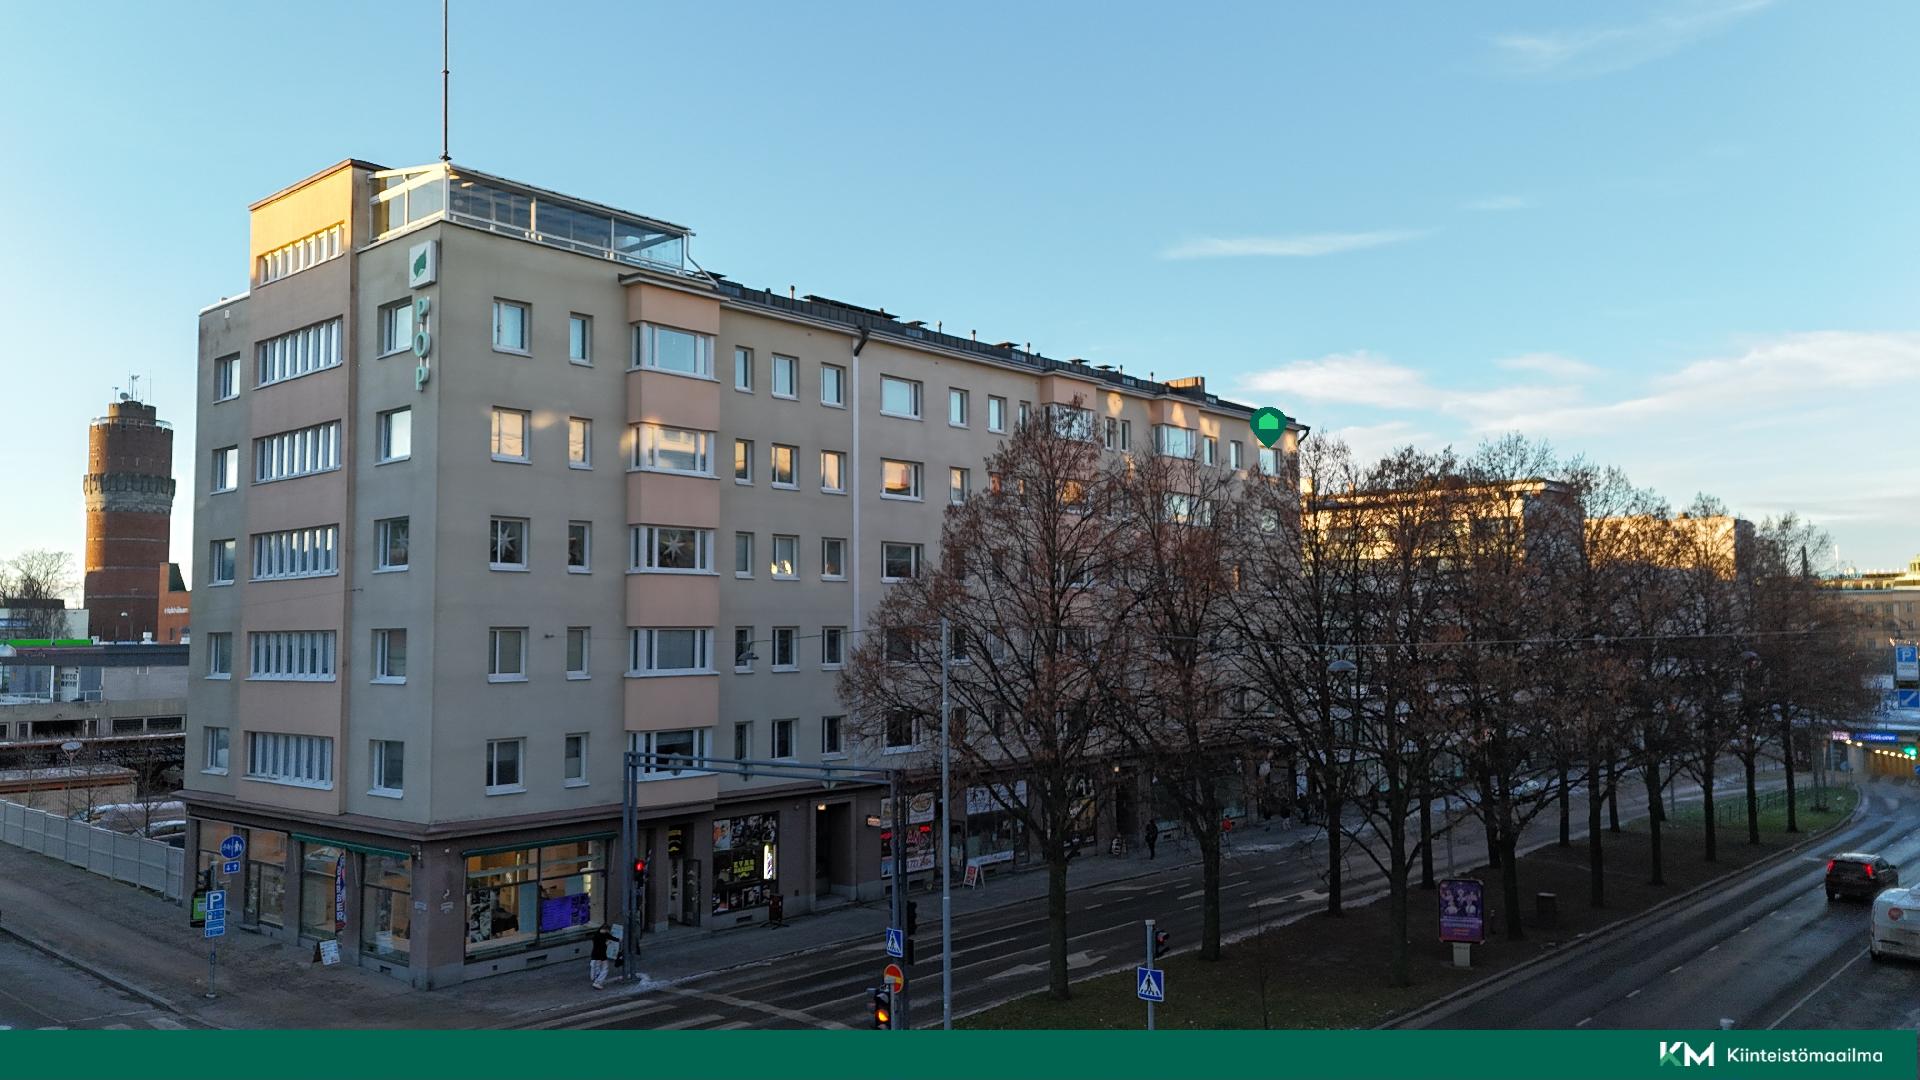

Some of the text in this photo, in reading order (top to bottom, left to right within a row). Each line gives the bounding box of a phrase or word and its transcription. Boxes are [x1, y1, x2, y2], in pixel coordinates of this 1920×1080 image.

[414, 296, 431, 392] POP
[1902, 650, 1912, 661] P
[209, 892, 223, 910] P
